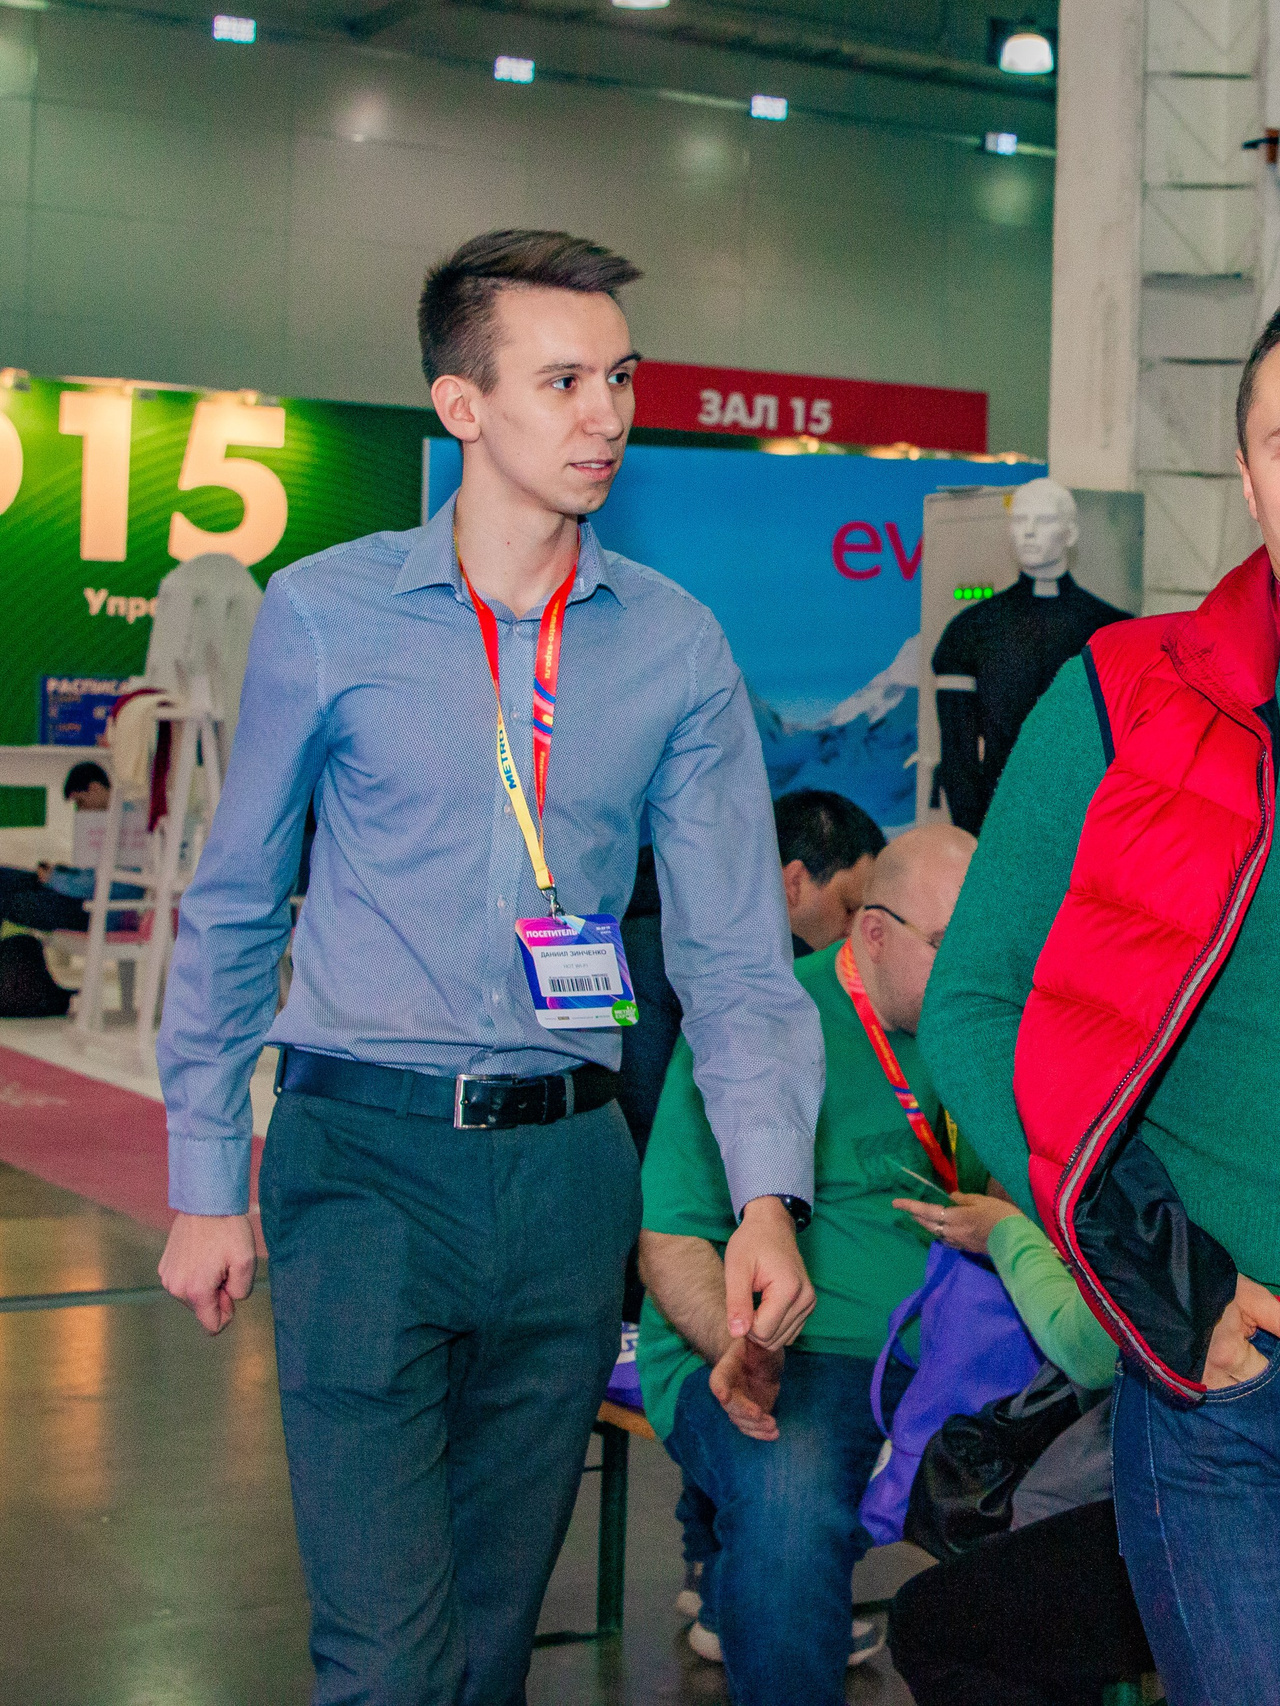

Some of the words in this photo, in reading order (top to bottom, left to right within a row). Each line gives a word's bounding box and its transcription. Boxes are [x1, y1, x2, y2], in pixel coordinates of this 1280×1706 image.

[697, 389, 779, 429] ЗАЛ
[789, 397, 833, 435] 15
[0, 390, 289, 568] 15
[526, 928, 579, 938] ПОСЕТИТЕЛЬ
